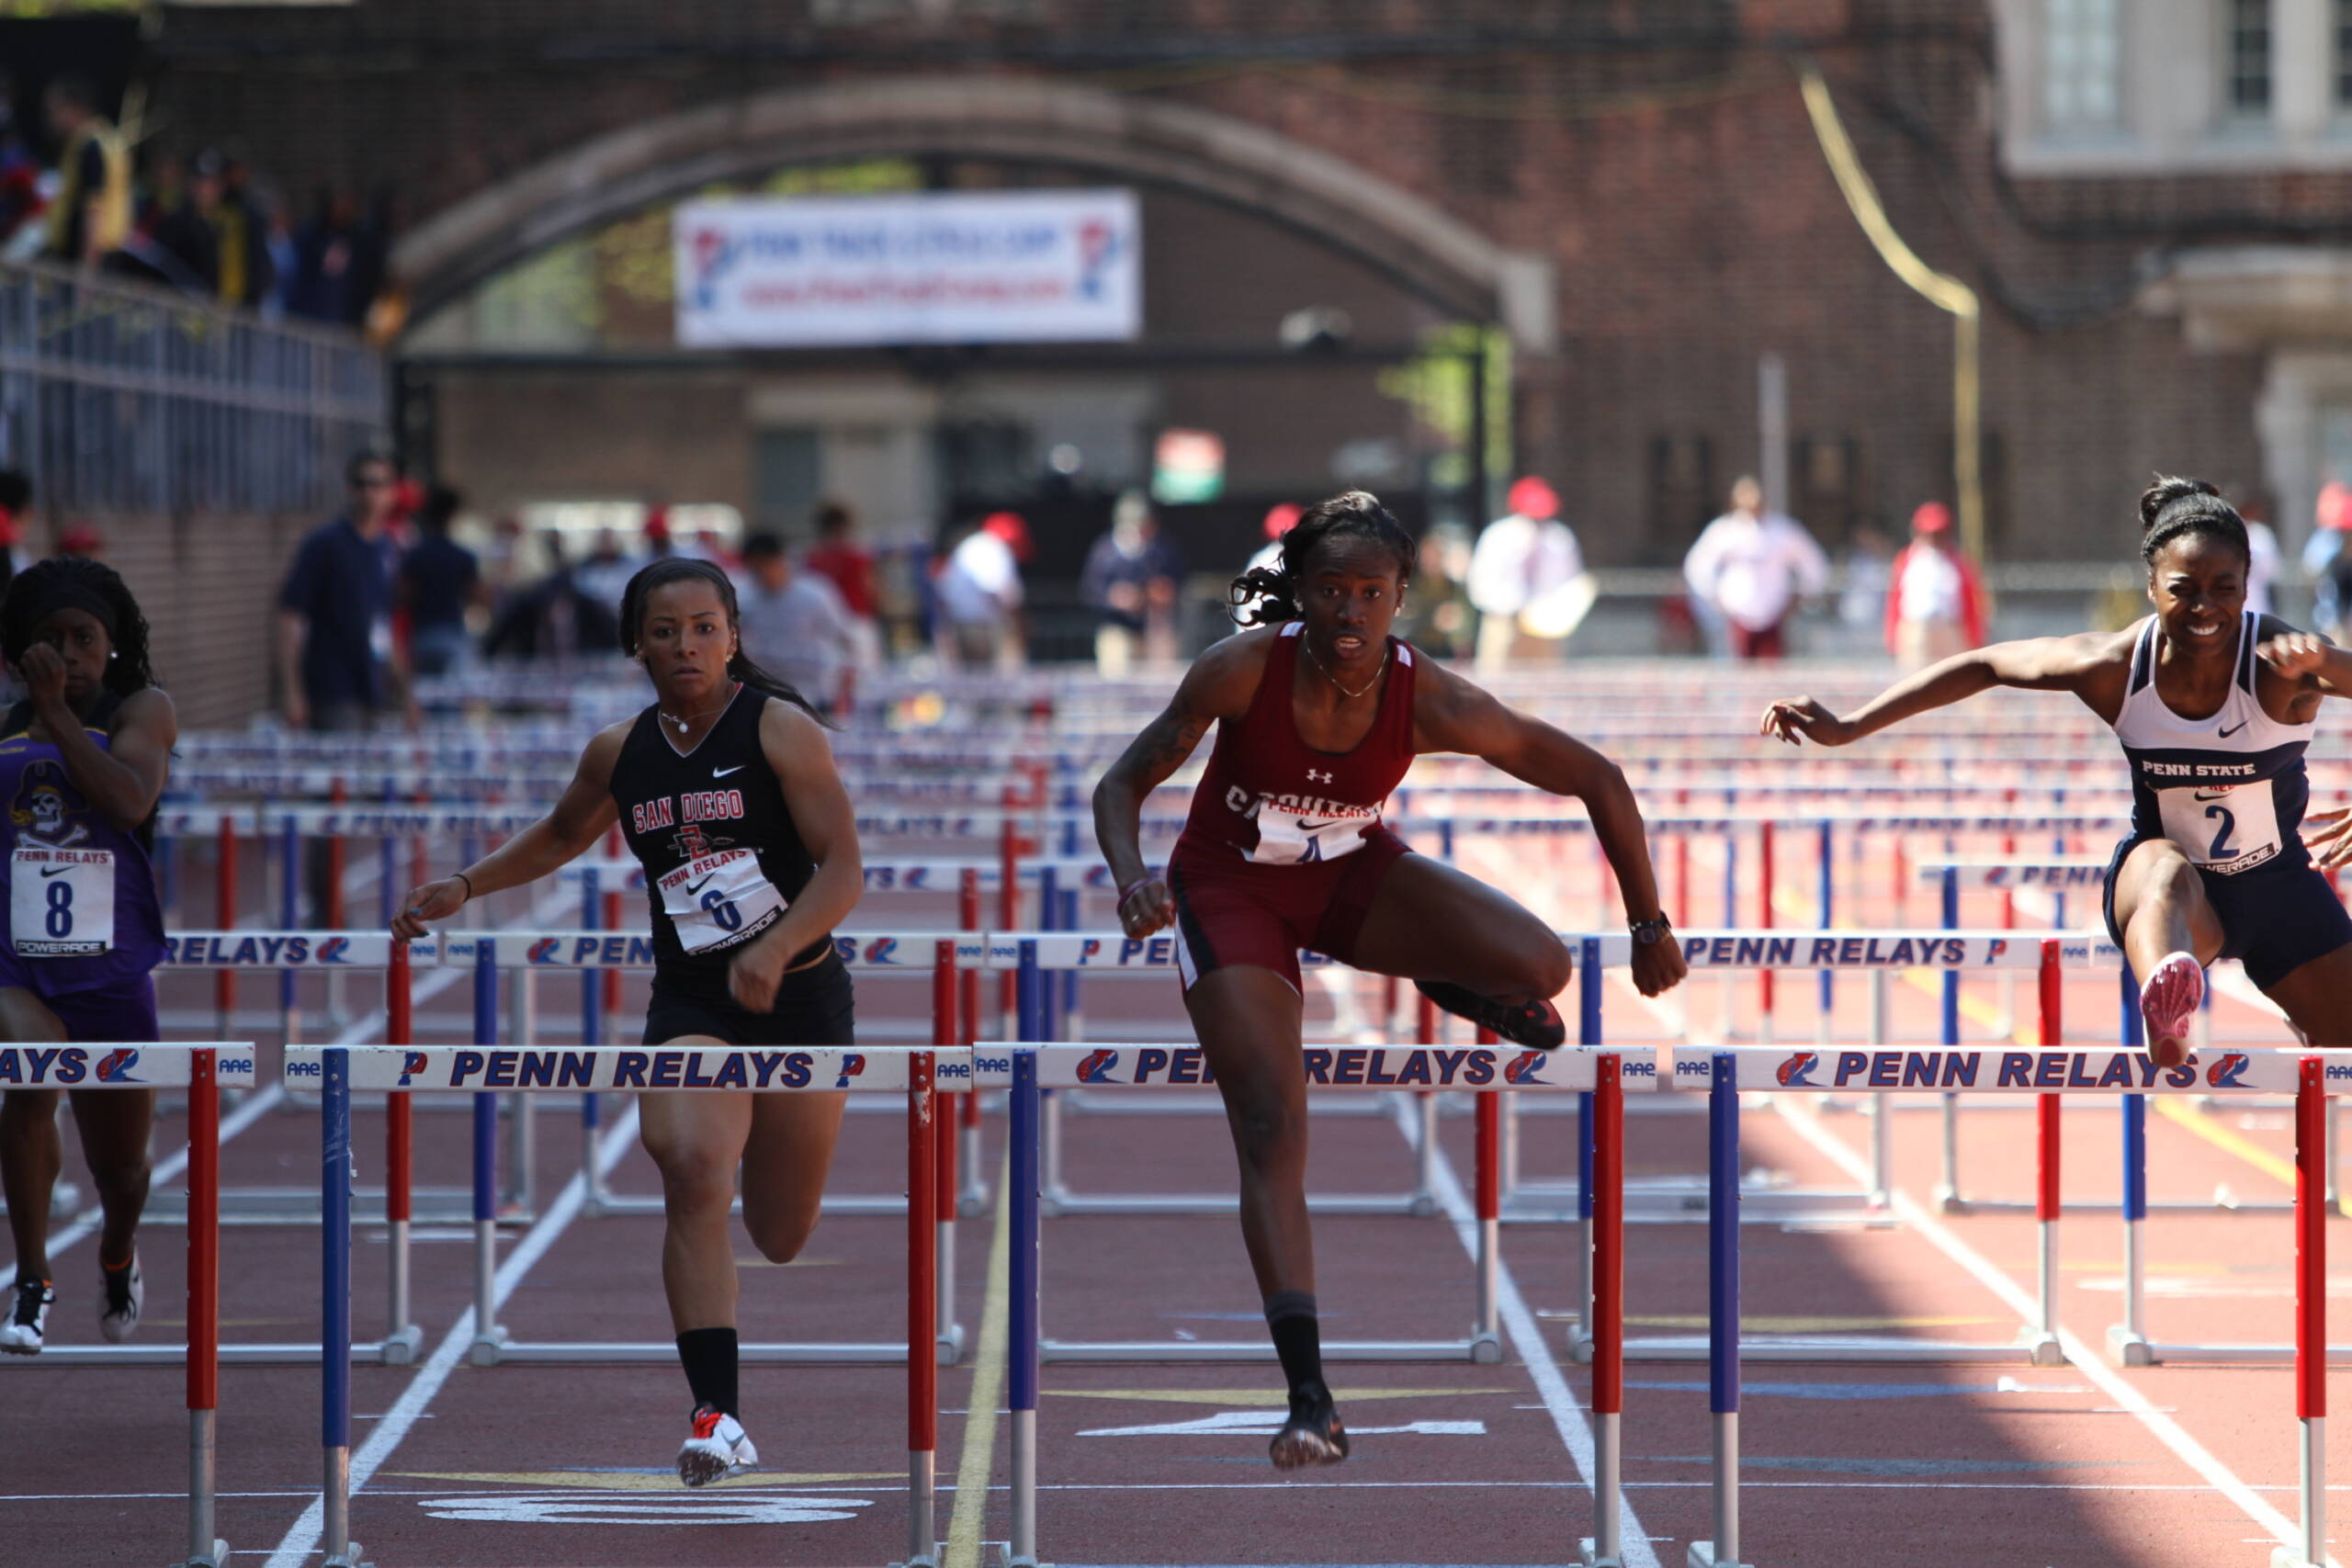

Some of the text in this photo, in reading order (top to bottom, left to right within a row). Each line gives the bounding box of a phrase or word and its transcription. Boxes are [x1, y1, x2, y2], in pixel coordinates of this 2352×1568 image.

[2142, 761, 2256, 776] PENN STATE
[633, 790, 744, 834] SAN DIEGO
[2205, 805, 2240, 860] 2
[16, 851, 109, 864] PENN RELAYS
[661, 850, 748, 892] PENN RELAYS
[46, 881, 74, 939] 8
[700, 888, 742, 931] 6
[17, 942, 102, 953] POWERADE
[571, 936, 655, 965] PEN
[1683, 937, 1794, 964] PENN
[1810, 937, 1965, 964] RELAYS
[449, 1052, 597, 1088] PENN
[612, 1052, 814, 1089] RELAYS
[1303, 1049, 1498, 1085] RELAYS
[1833, 1052, 2199, 1089] PENN RELAYS
